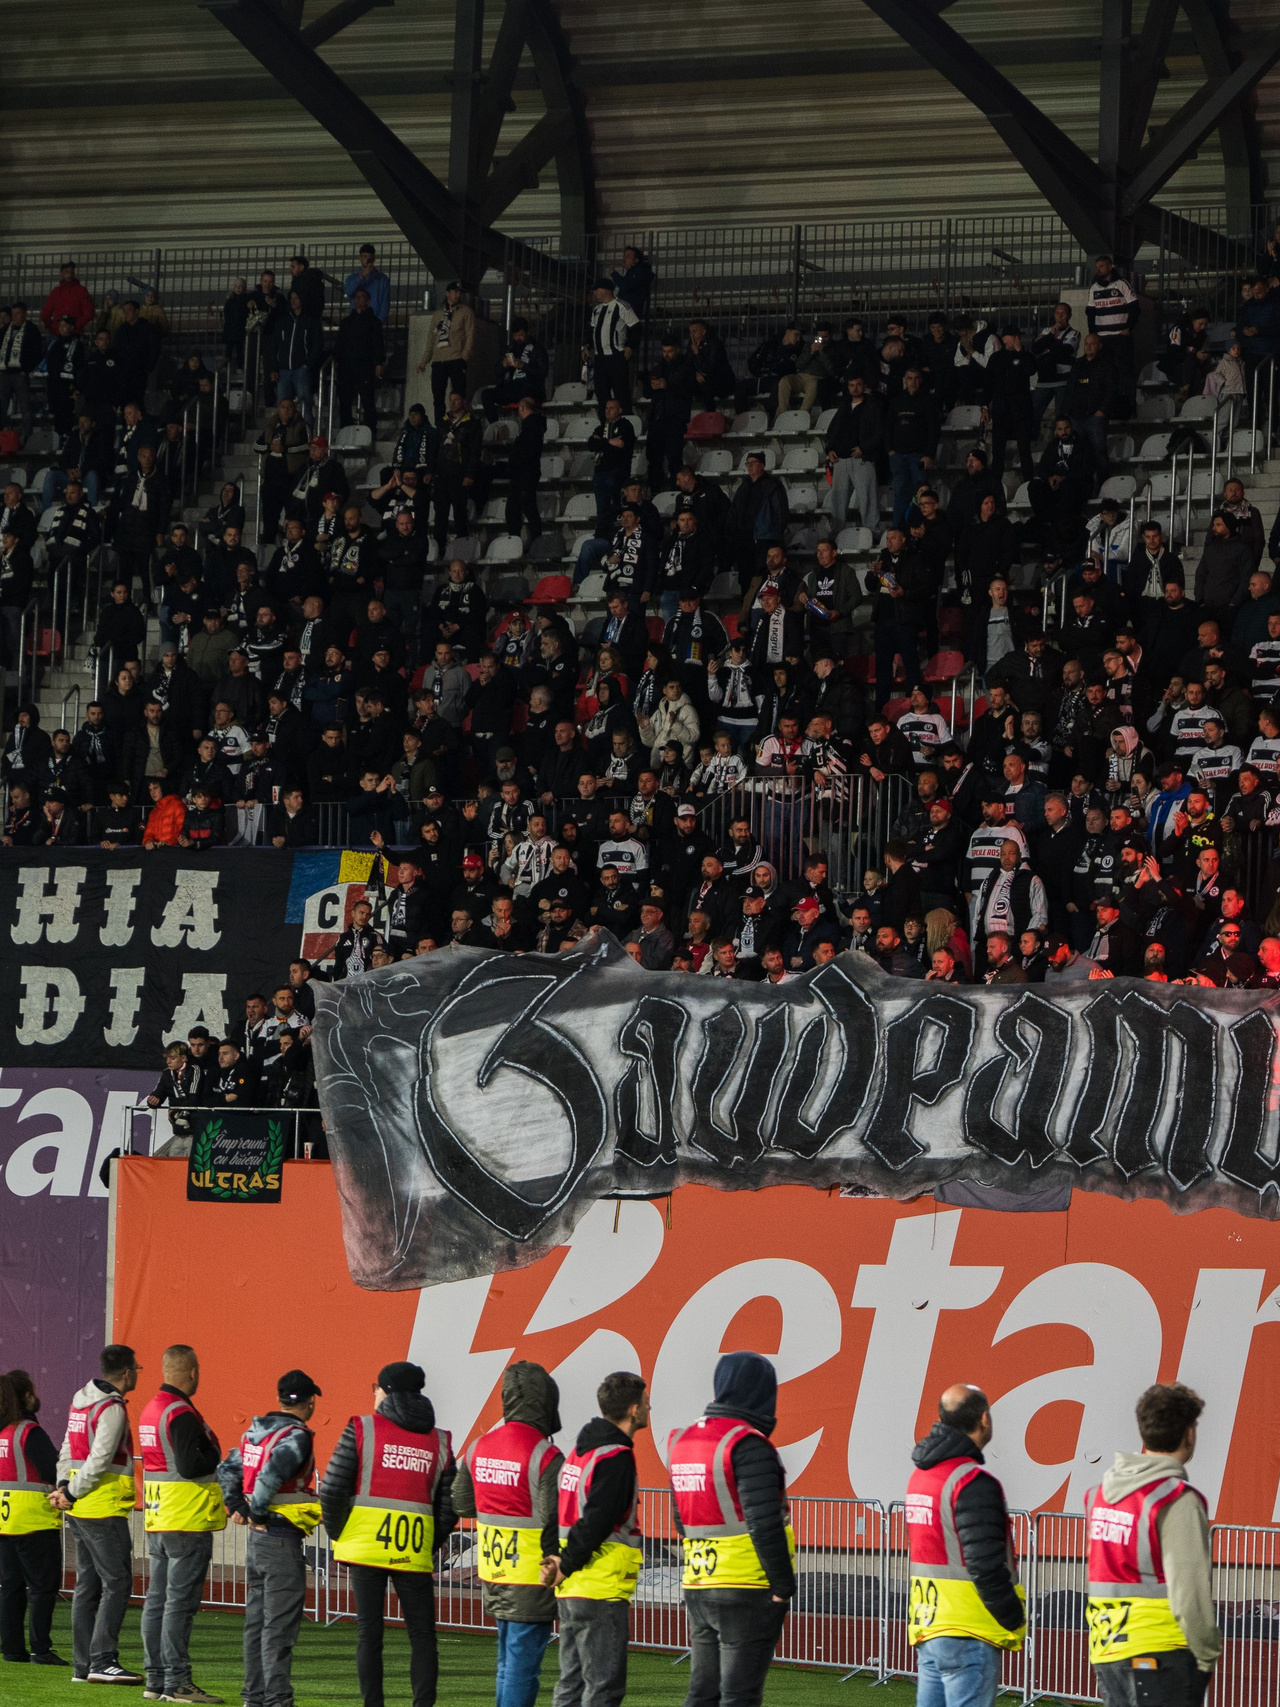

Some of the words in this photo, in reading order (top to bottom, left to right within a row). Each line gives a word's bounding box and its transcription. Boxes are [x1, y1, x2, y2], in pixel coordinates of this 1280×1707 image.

[213, 1155, 229, 1165] cu
[191, 1169, 280, 1192] ULTRAS
[398, 1445, 434, 1460] EXECUTION
[382, 1454, 432, 1474] SECURITY
[475, 1467, 521, 1487] SECURITY
[376, 1512, 424, 1554] 400
